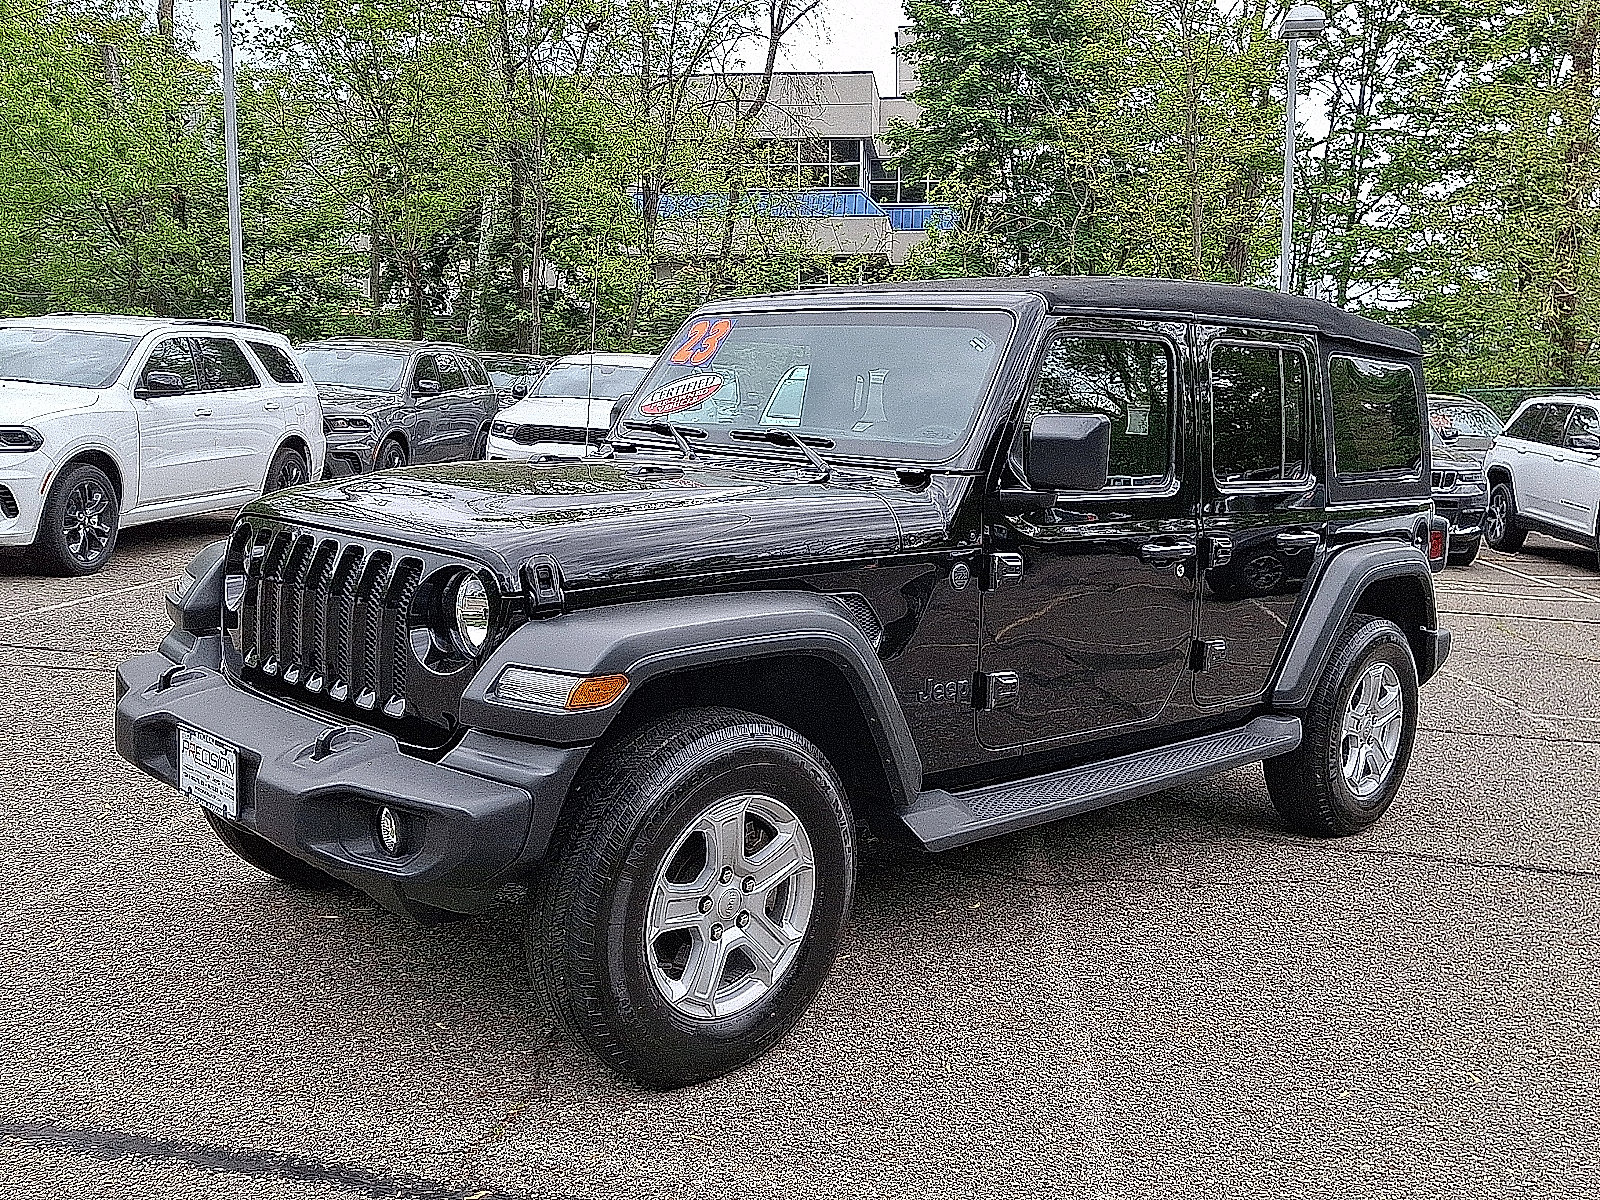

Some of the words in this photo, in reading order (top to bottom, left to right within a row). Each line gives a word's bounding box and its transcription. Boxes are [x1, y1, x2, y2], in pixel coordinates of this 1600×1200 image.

[670, 318, 732, 365] 23
[650, 376, 716, 402] CERTIFIED
[657, 393, 700, 413] VEHICLE
[915, 678, 971, 703] Jeep
[182, 740, 236, 777] PRECISION
